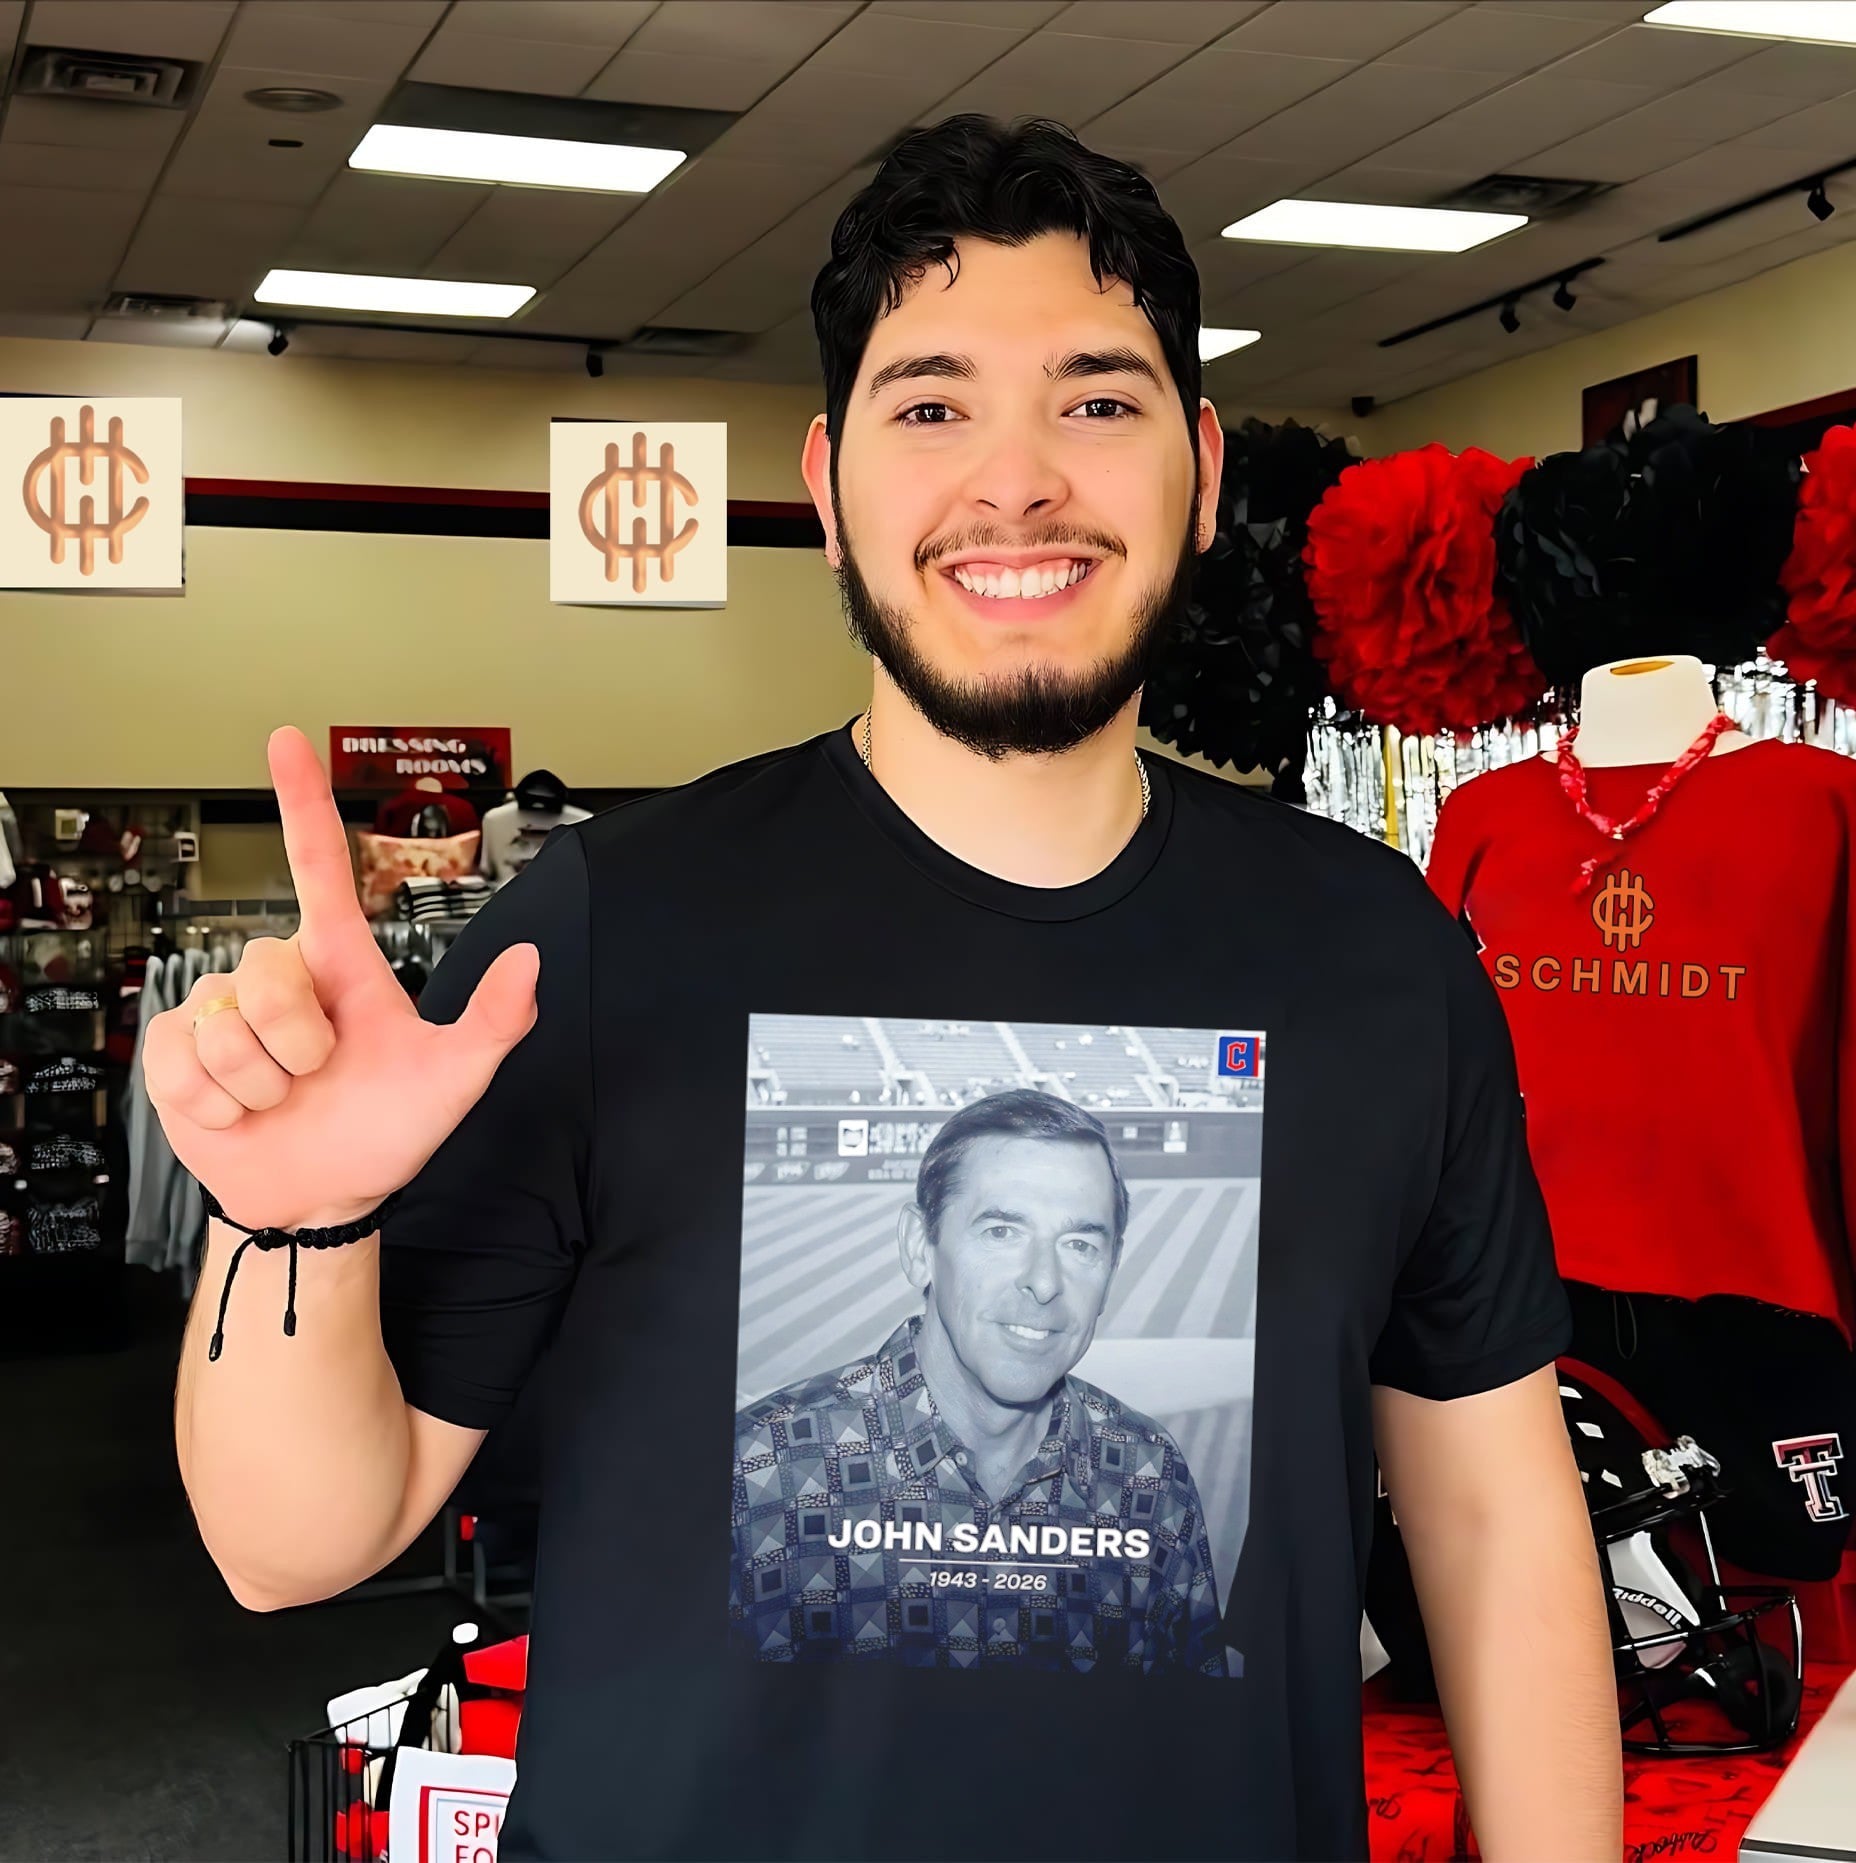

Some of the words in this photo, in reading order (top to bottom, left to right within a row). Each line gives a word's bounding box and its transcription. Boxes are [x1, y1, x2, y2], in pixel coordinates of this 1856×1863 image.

[342, 737, 467, 753] DRESSING
[396, 758, 487, 774] ROOMS
[1493, 954, 1747, 1001] SCHMIDT
[1226, 1041, 1247, 1071] C
[827, 1518, 943, 1551] JOHN
[952, 1522, 1151, 1559] SANDERS
[929, 1570, 978, 1589] 1943
[993, 1573, 1048, 1591] 2026
